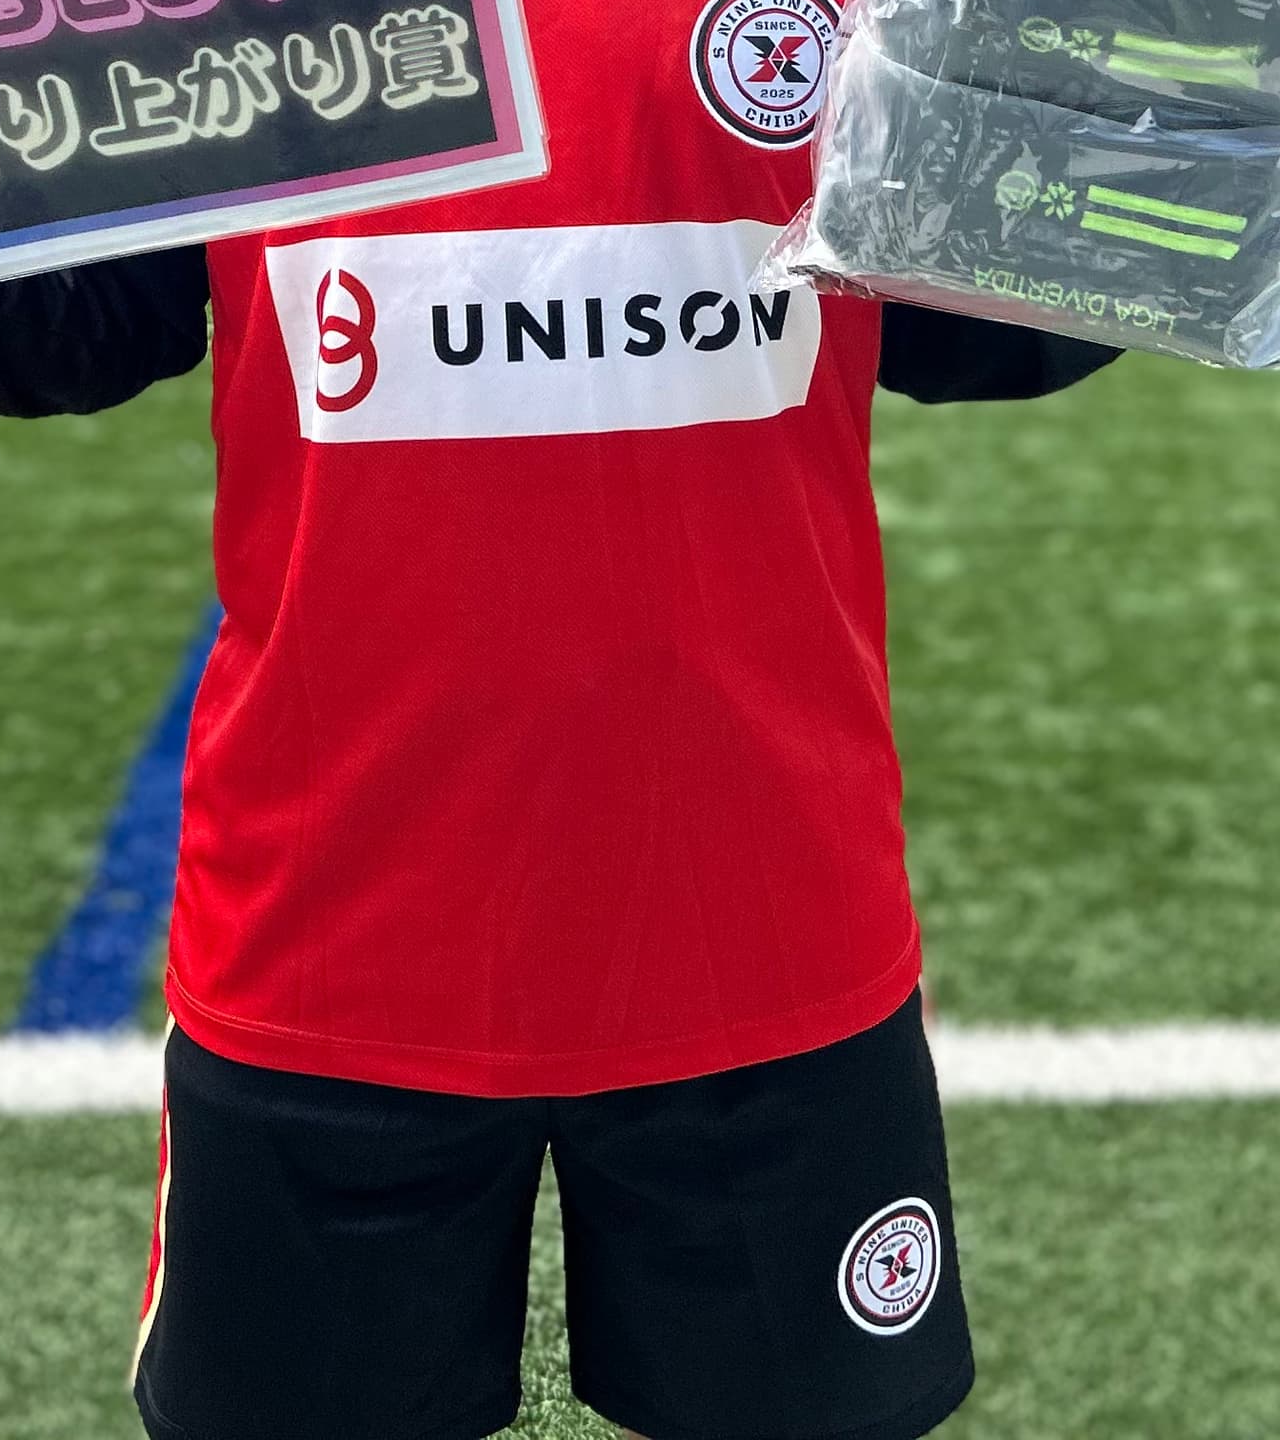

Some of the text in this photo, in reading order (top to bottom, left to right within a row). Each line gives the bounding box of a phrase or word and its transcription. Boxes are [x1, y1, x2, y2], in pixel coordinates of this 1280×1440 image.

[754, 20, 797, 32] SINCE
[713, 46, 725, 59] S
[759, 89, 795, 100] 2025
[744, 106, 809, 129] CHIBA
[431, 290, 791, 366] UNISON
